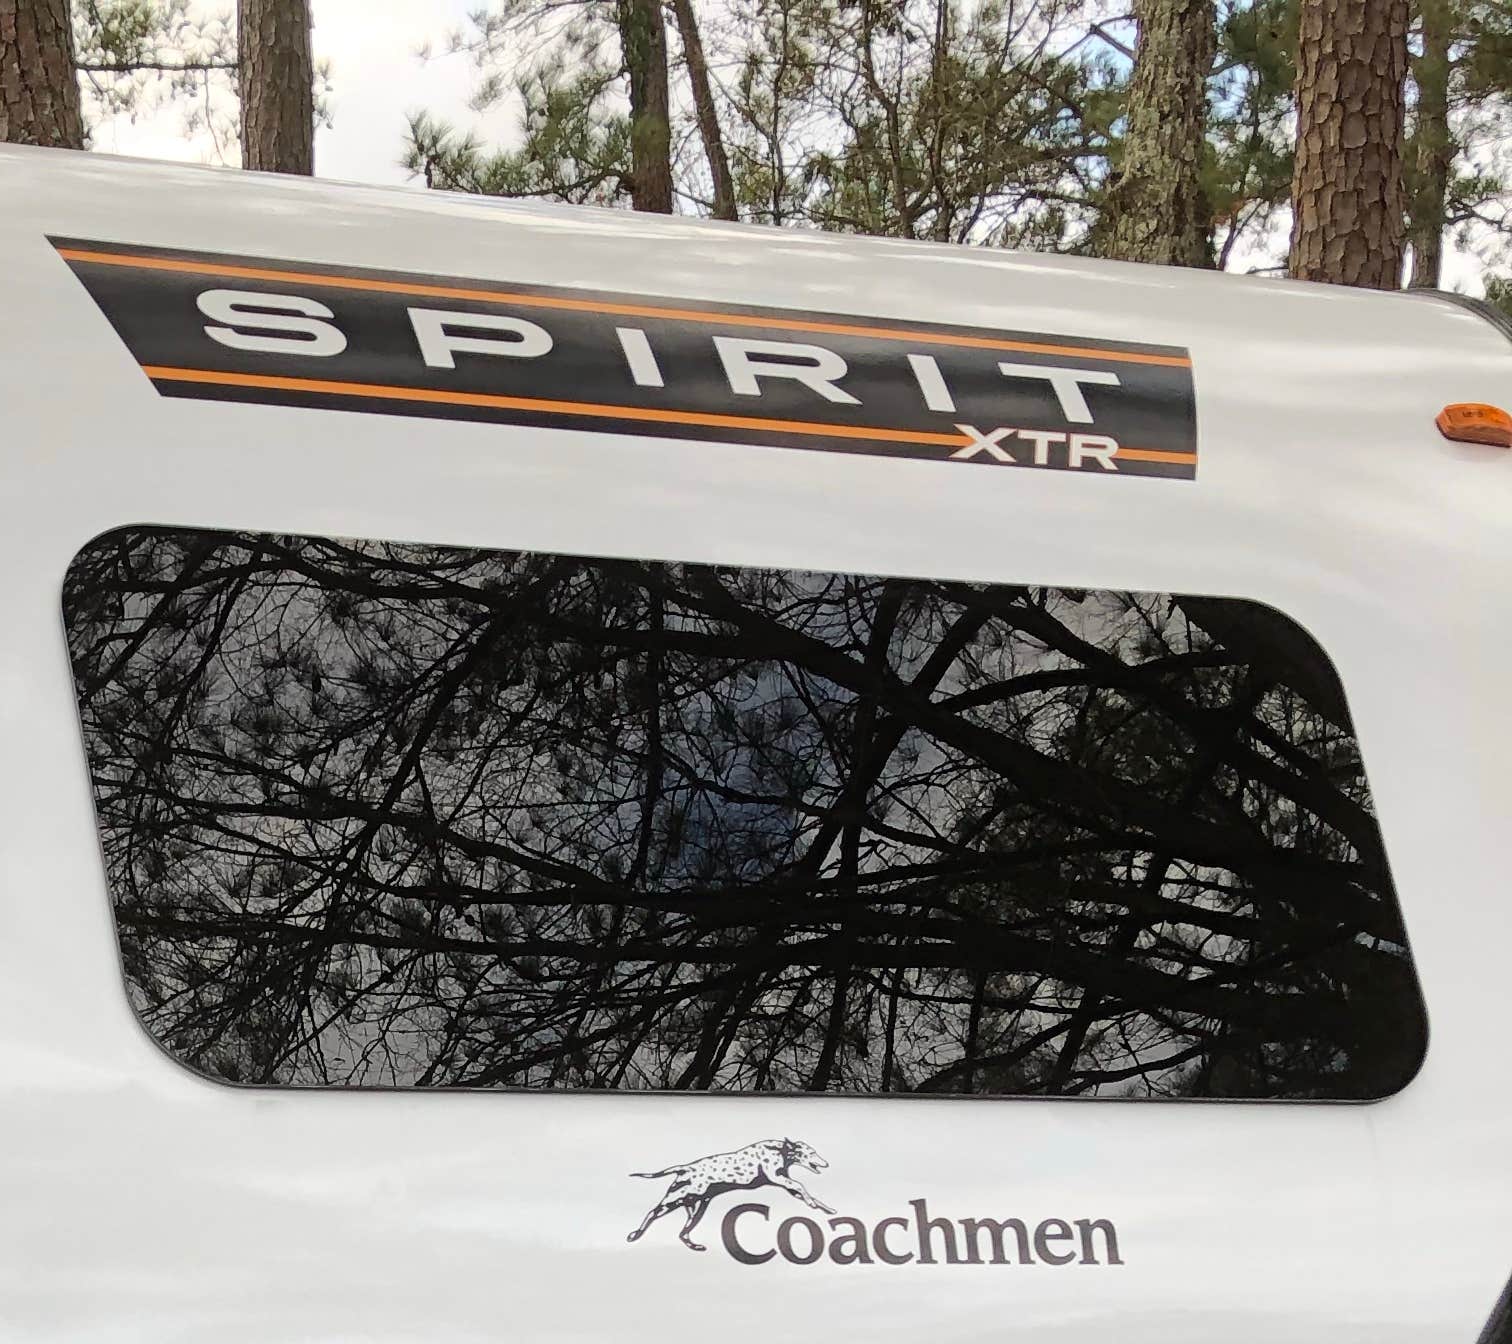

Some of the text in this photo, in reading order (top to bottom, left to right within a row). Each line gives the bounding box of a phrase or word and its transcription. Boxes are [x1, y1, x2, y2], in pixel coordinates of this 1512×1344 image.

[194, 287, 1122, 426] SPIRIT
[949, 422, 1121, 472] XTR
[720, 1197, 1126, 1267] Coachmen
